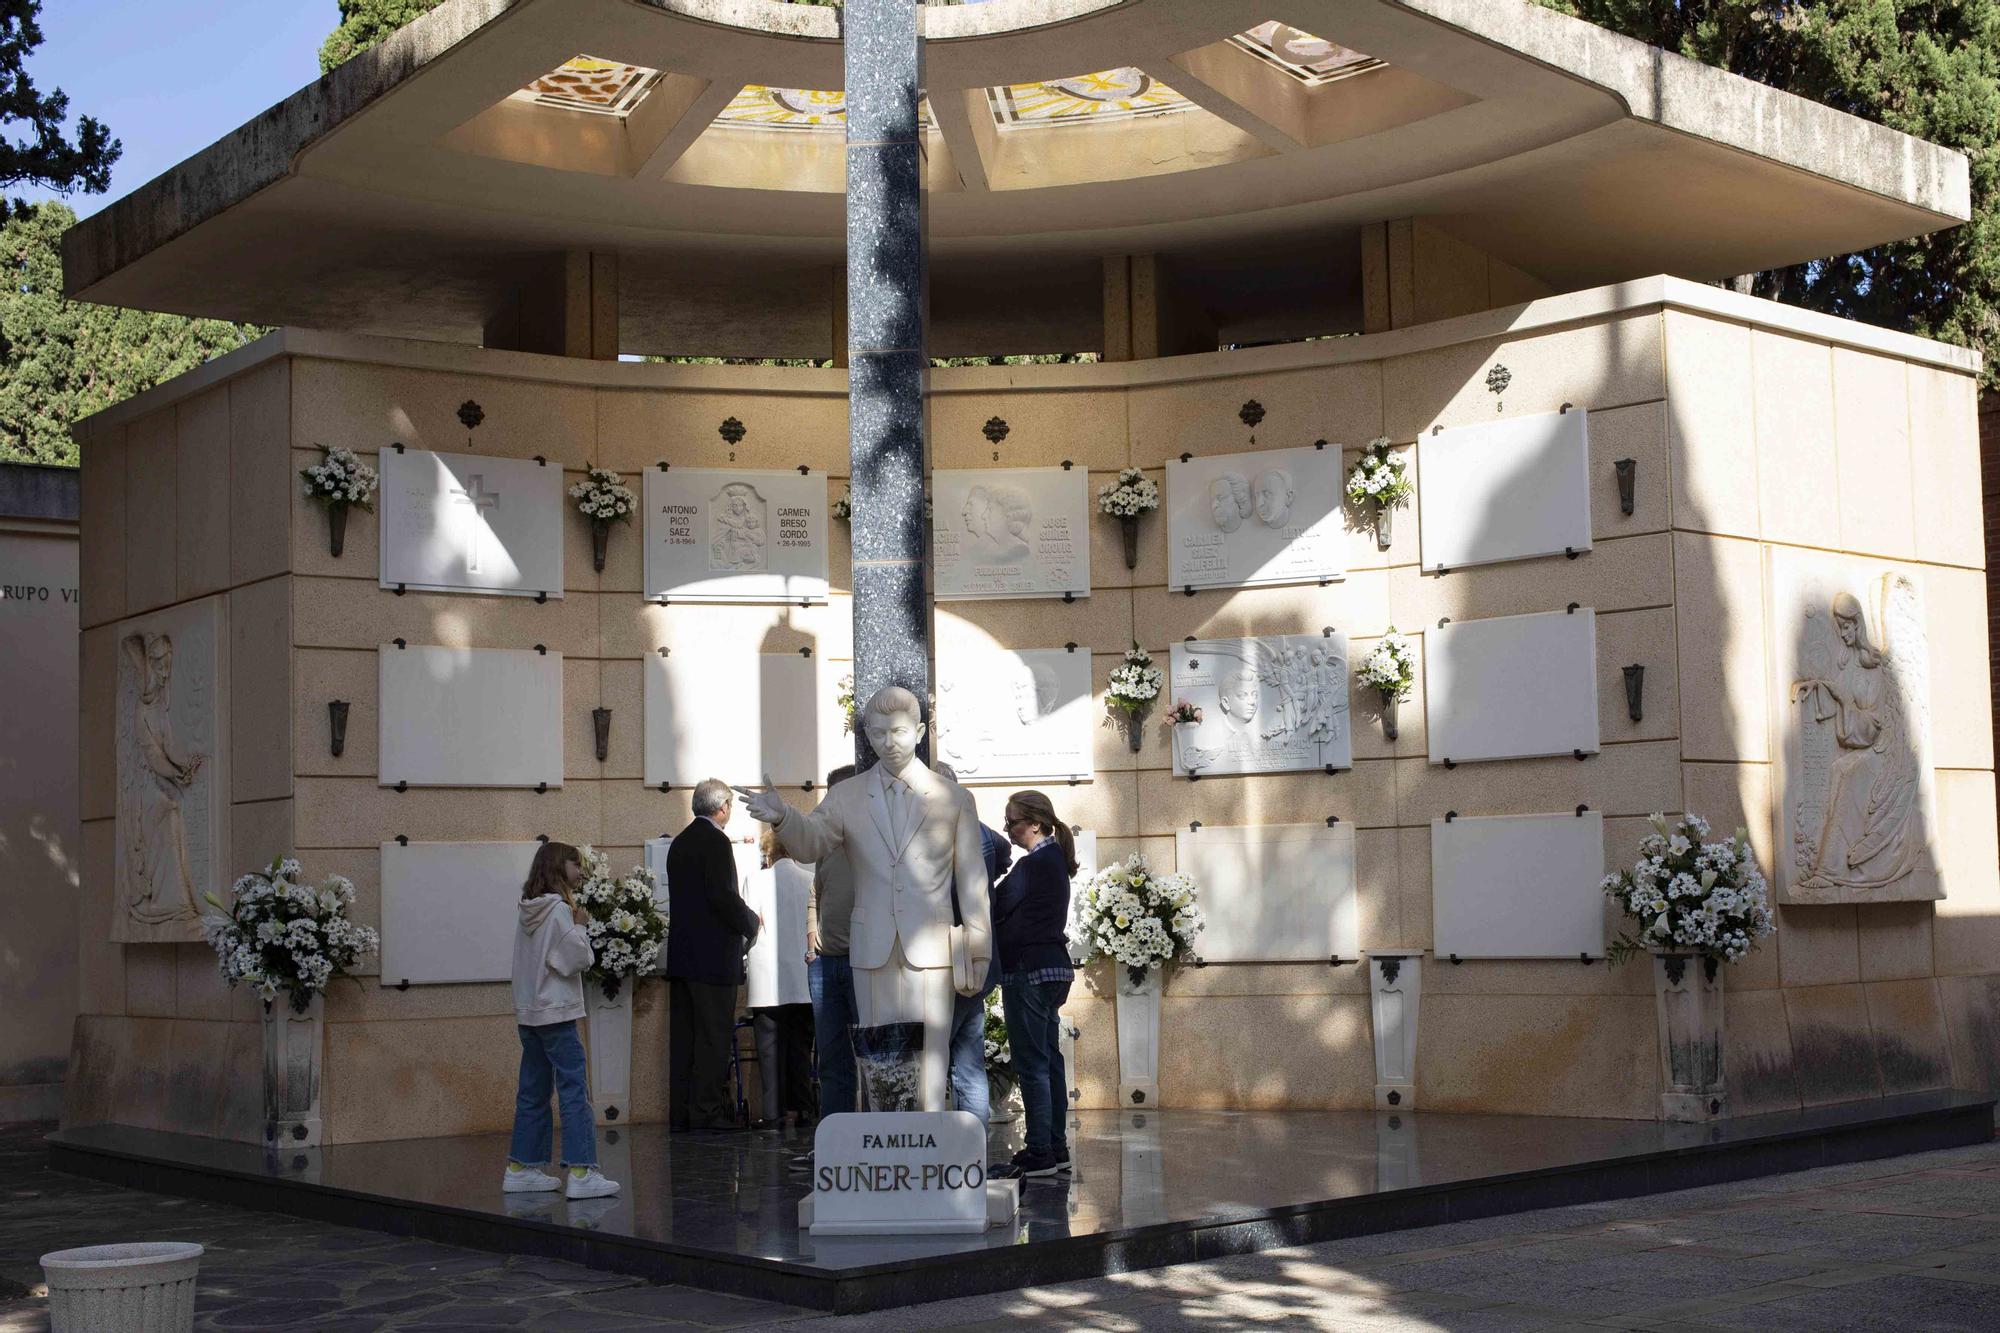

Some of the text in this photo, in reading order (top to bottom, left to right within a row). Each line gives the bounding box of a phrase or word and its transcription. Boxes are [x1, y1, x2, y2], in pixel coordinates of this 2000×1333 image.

[1497, 401, 1503, 412] 5
[467, 437, 472, 447] 1
[1249, 435, 1255, 445] 4
[729, 452, 735, 461] 2
[662, 505, 698, 515] ANTONIO
[777, 507, 810, 517] CARMEN
[670, 516, 690, 526] PICO
[780, 518, 807, 528] BRESO
[669, 527, 690, 537] SAEZ
[779, 529, 808, 539] GORDO
[0, 585, 49, 601] RUPO
[863, 1134, 937, 1148] FAMILIA
[817, 1160, 984, 1192] SUÑER-PICÓ
